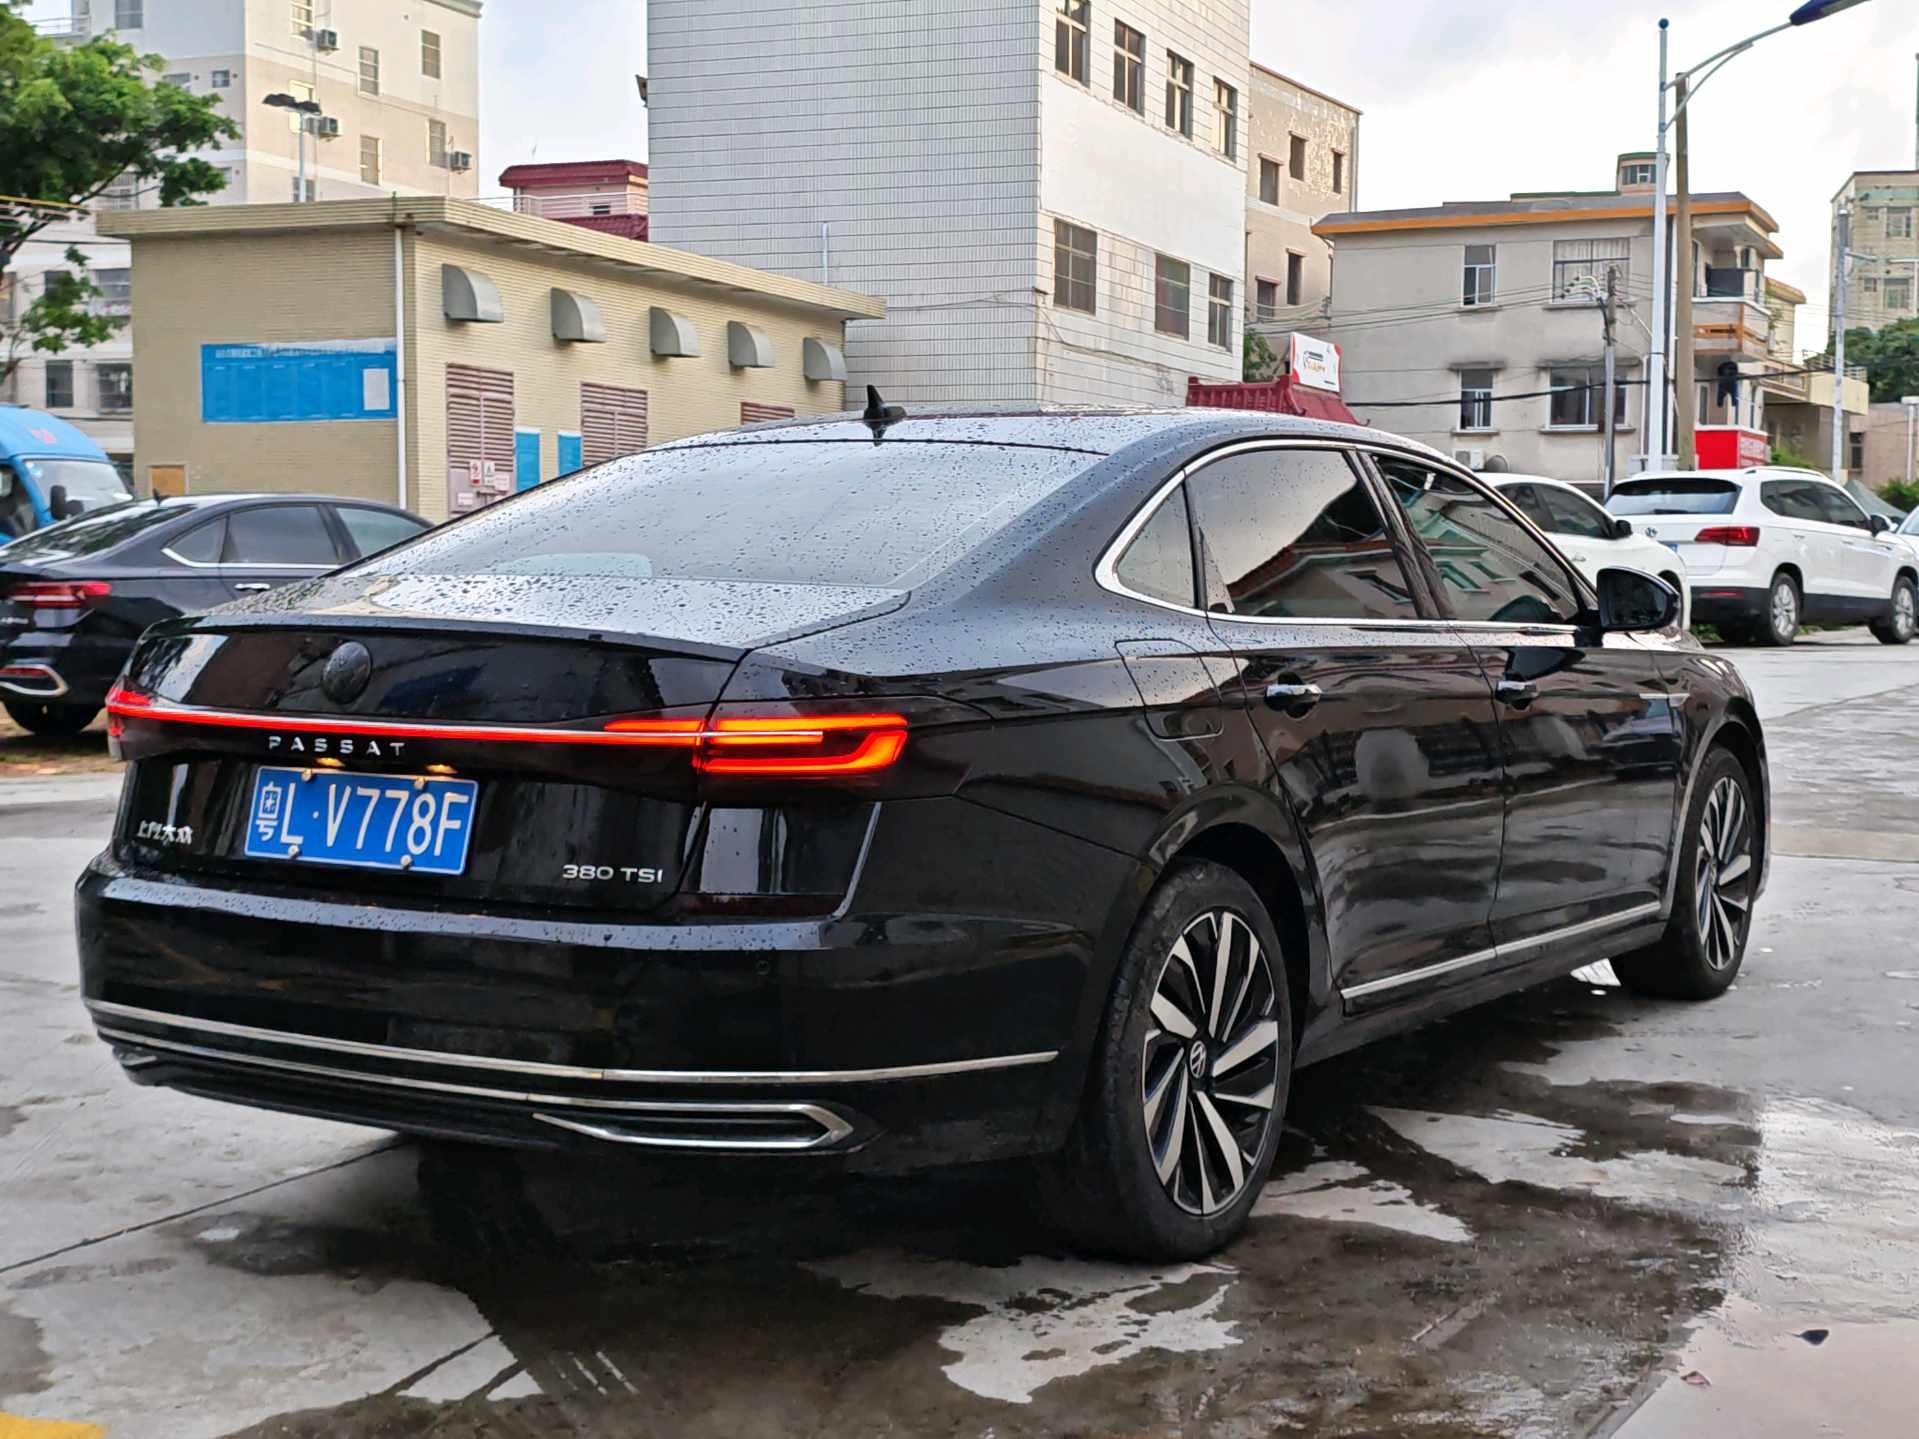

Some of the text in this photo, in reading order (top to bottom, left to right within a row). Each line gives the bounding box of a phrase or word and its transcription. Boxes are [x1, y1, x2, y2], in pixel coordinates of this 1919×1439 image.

[269, 735, 405, 756] PASSAT
[255, 781, 470, 857] 粤L·V778F
[562, 864, 664, 883] 380 TSI
